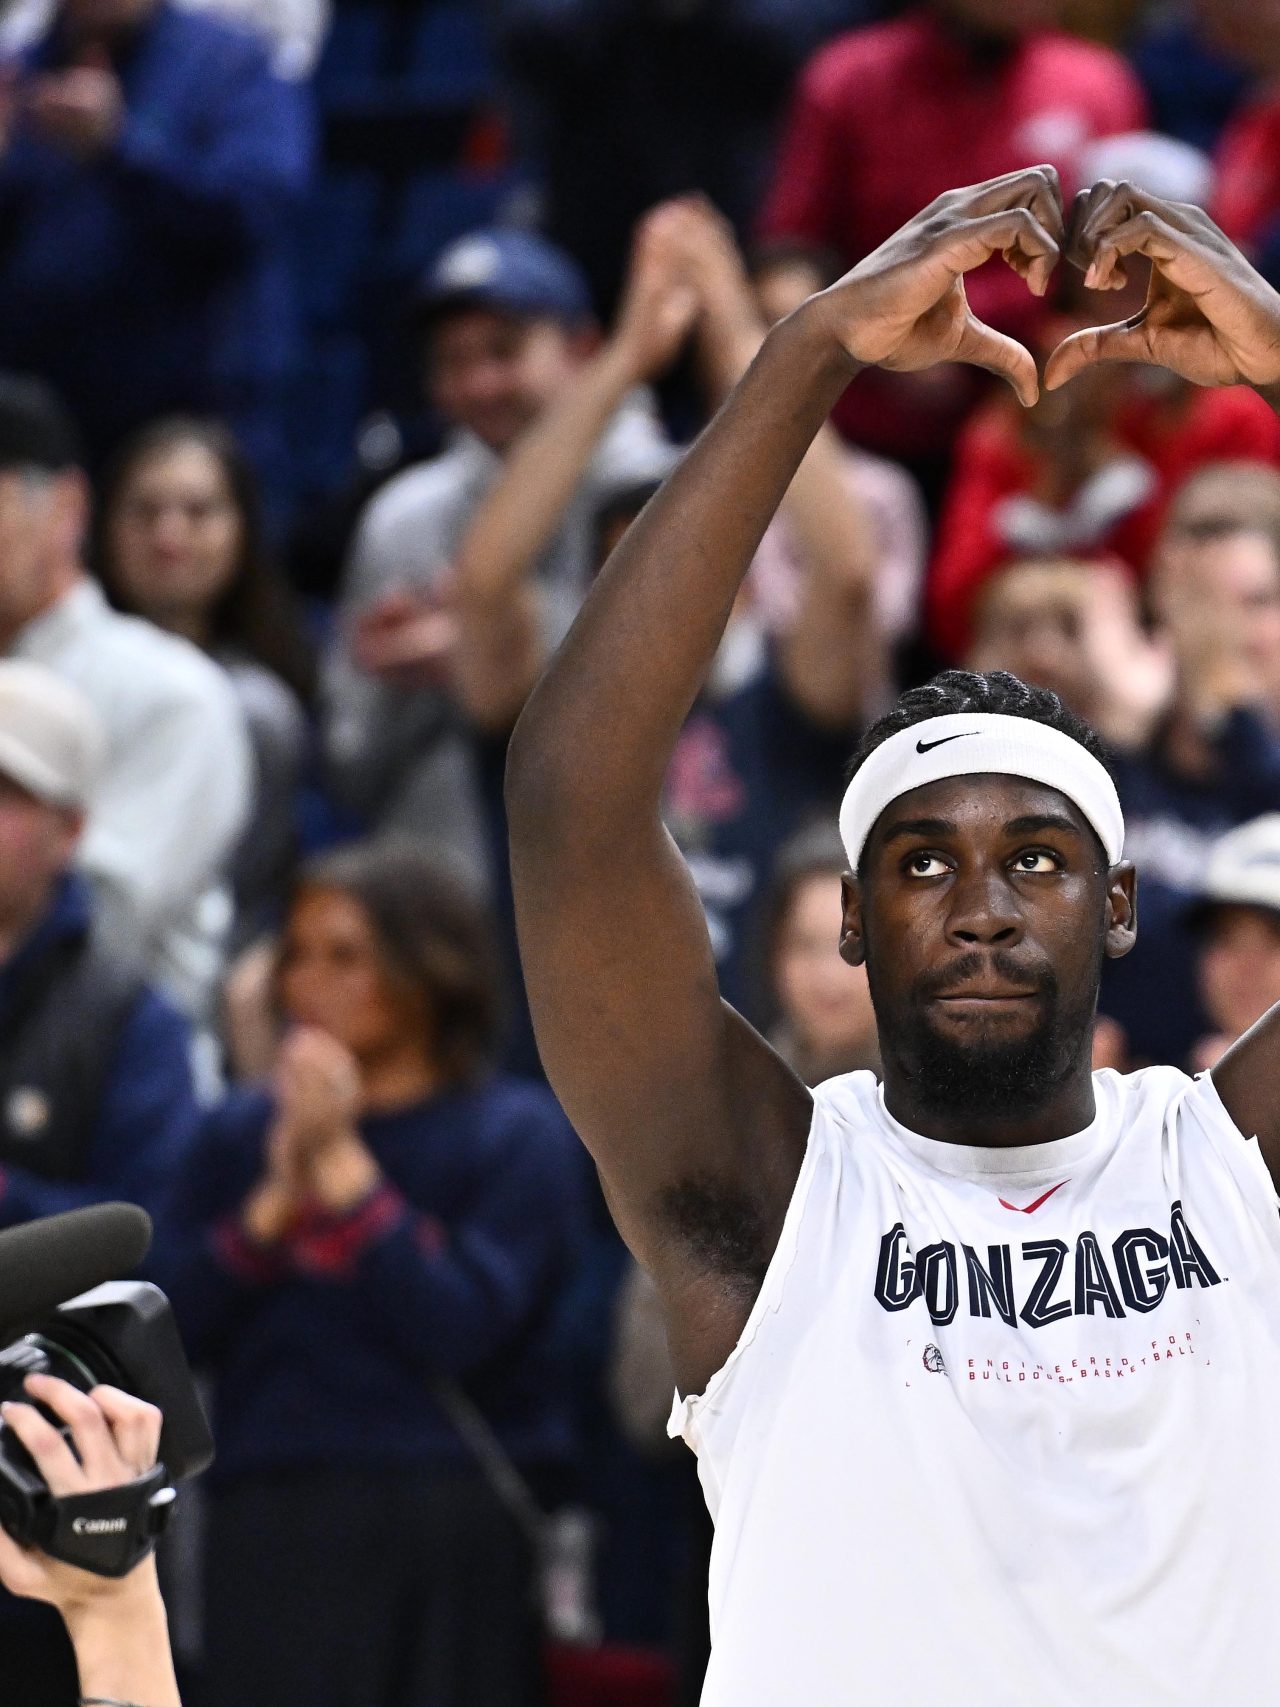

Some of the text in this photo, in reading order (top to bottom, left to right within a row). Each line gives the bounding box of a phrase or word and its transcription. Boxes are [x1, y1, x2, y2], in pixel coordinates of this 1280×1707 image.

[874, 1200, 1222, 1329] GONZAGA
[968, 1332, 1192, 1373] ENGINEERED FOR
[1080, 1345, 1195, 1379] BASKETBALL
